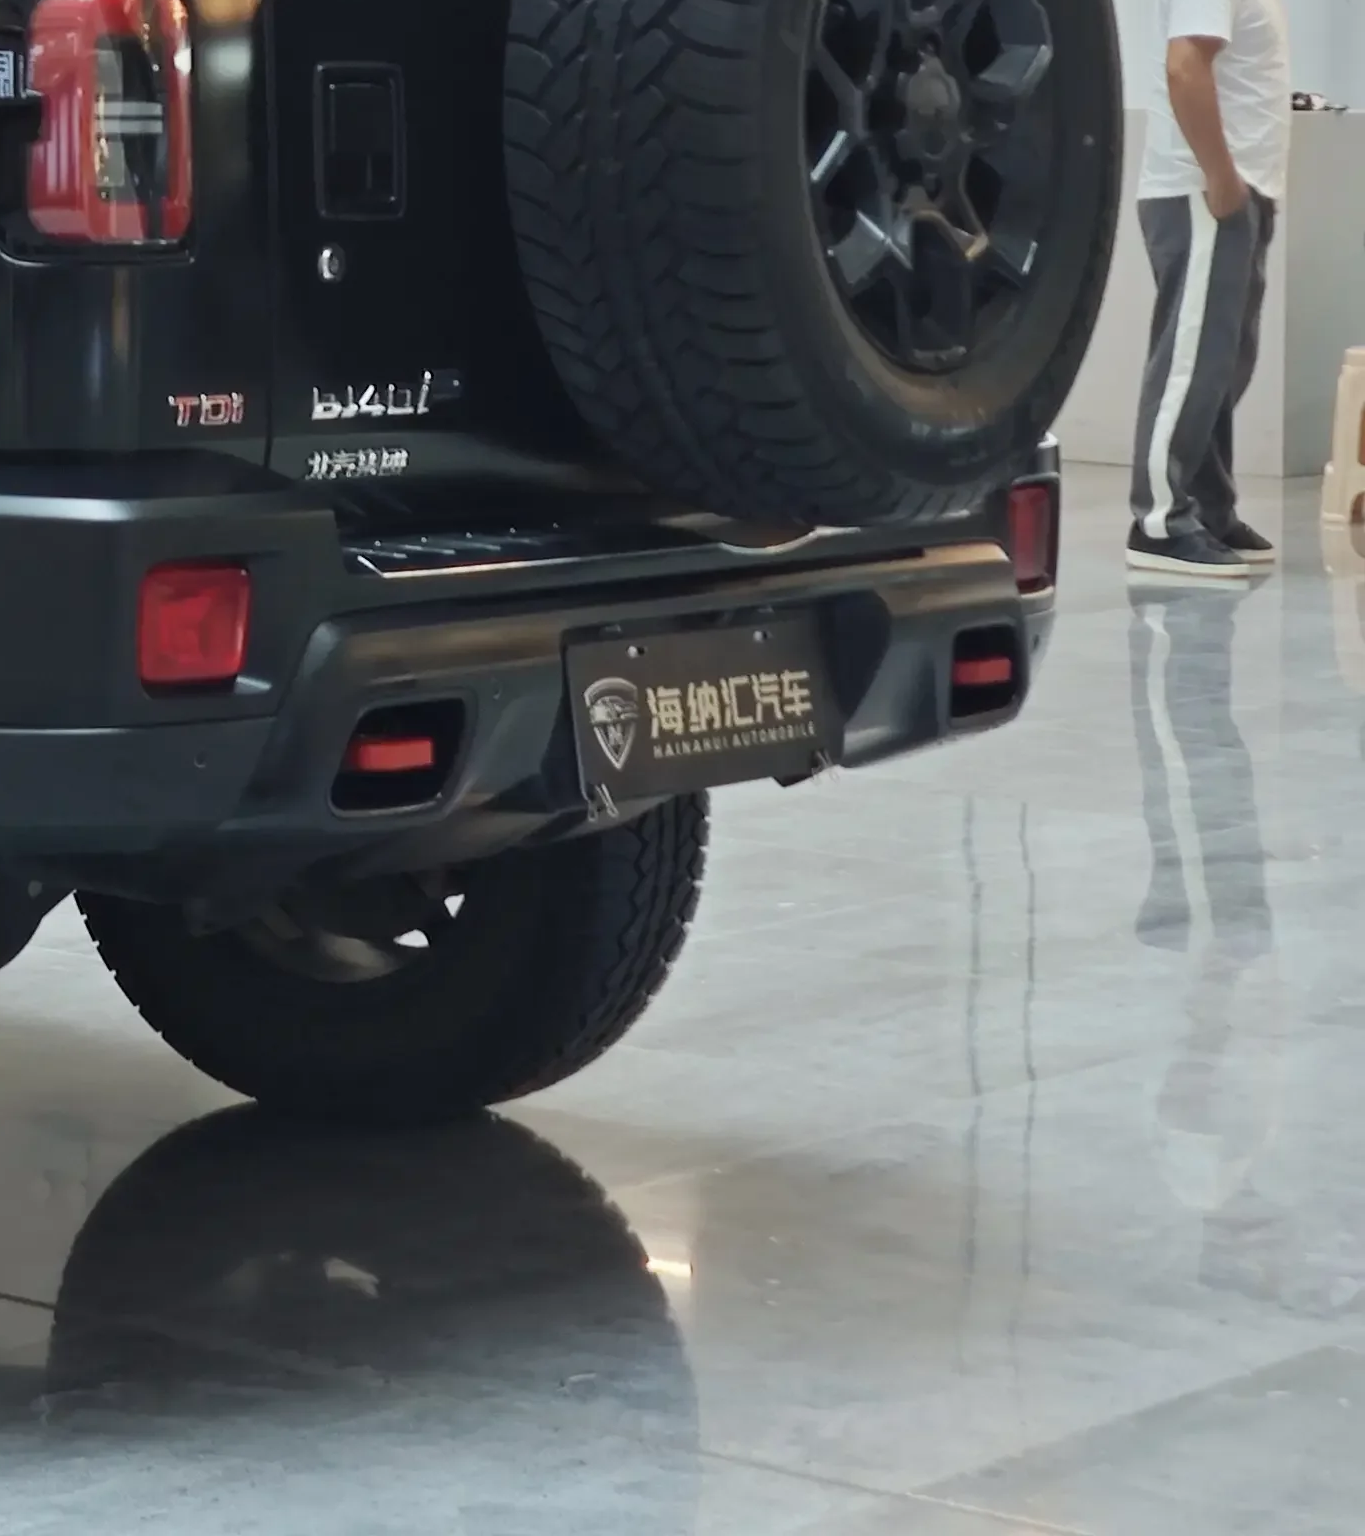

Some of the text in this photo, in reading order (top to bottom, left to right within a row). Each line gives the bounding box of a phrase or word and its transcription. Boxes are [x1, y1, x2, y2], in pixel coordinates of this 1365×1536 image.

[167, 391, 246, 427] TDI
[645, 668, 813, 739] 海纳汇汽车
[731, 720, 817, 748] AUTOMOBILE
